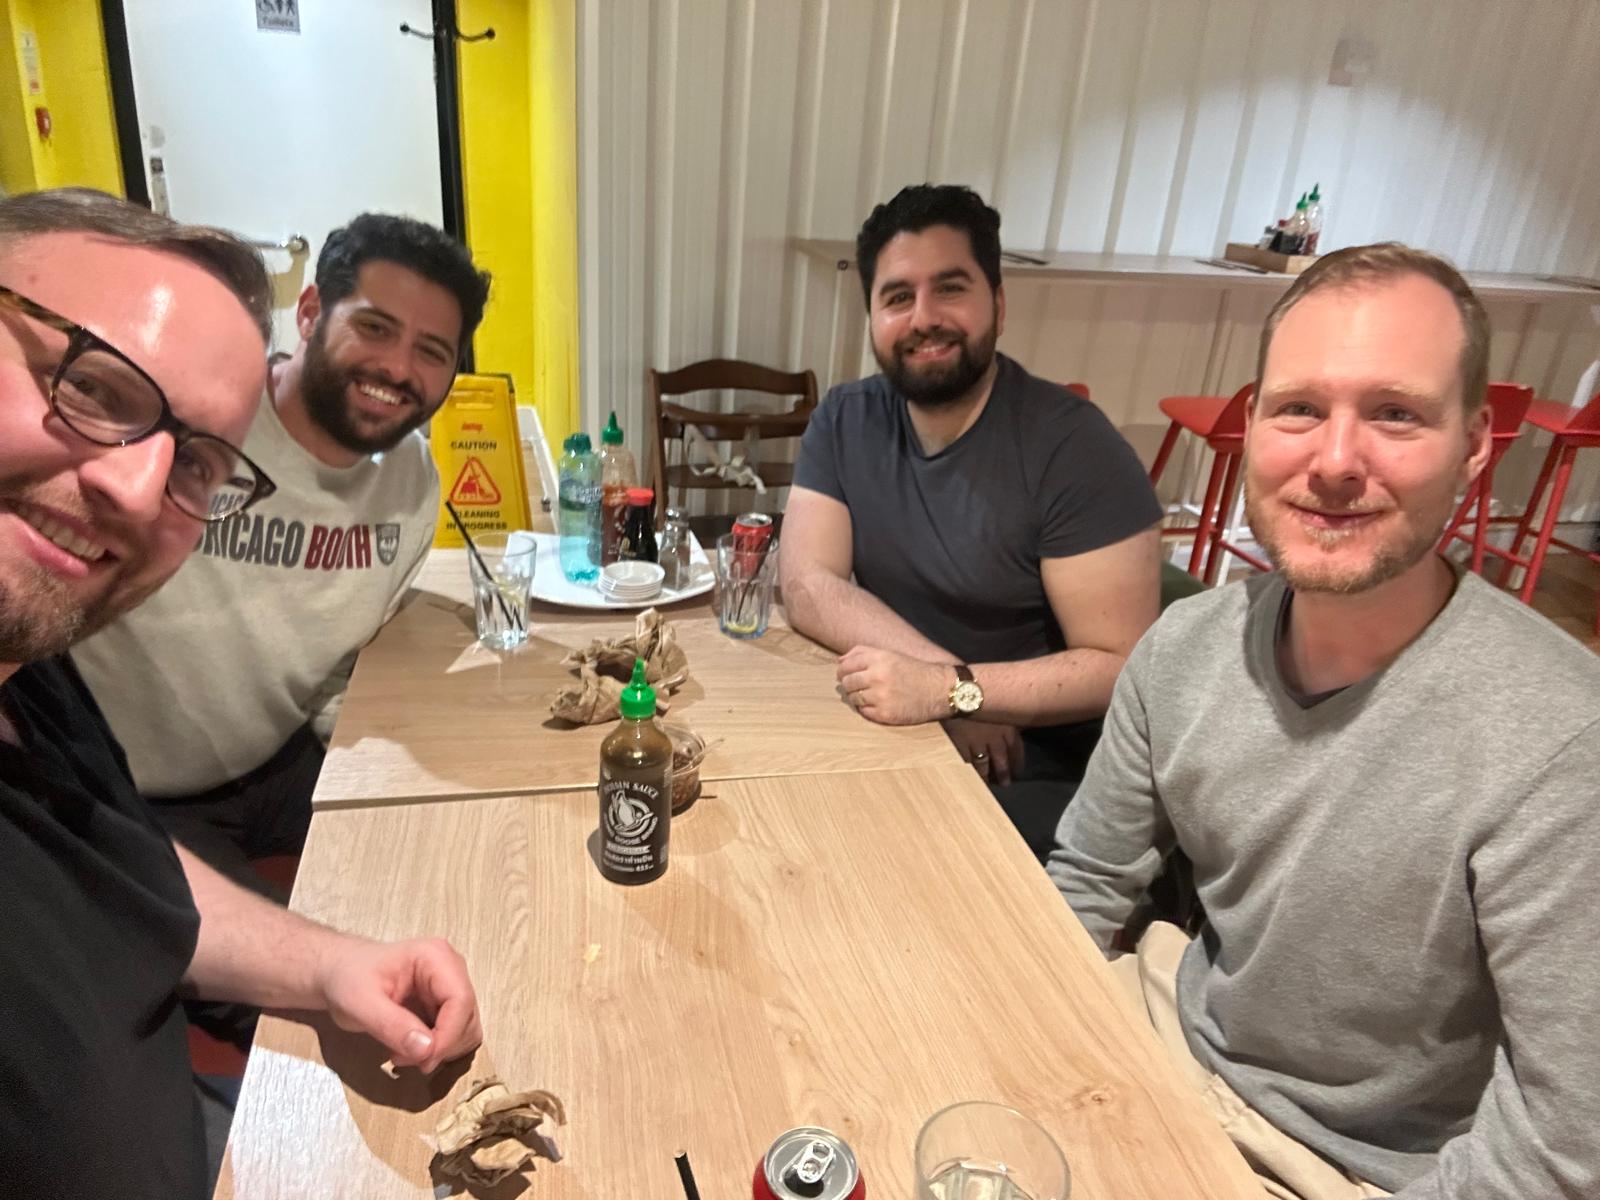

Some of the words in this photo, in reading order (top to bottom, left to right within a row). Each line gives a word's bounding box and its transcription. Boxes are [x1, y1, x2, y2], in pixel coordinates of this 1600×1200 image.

[450, 441, 497, 450] CAUTION
[455, 510, 500, 519] LEANING
[460, 521, 508, 530] ROGRESS
[195, 512, 306, 569] HICAGO
[633, 782, 659, 800] SAUCE
